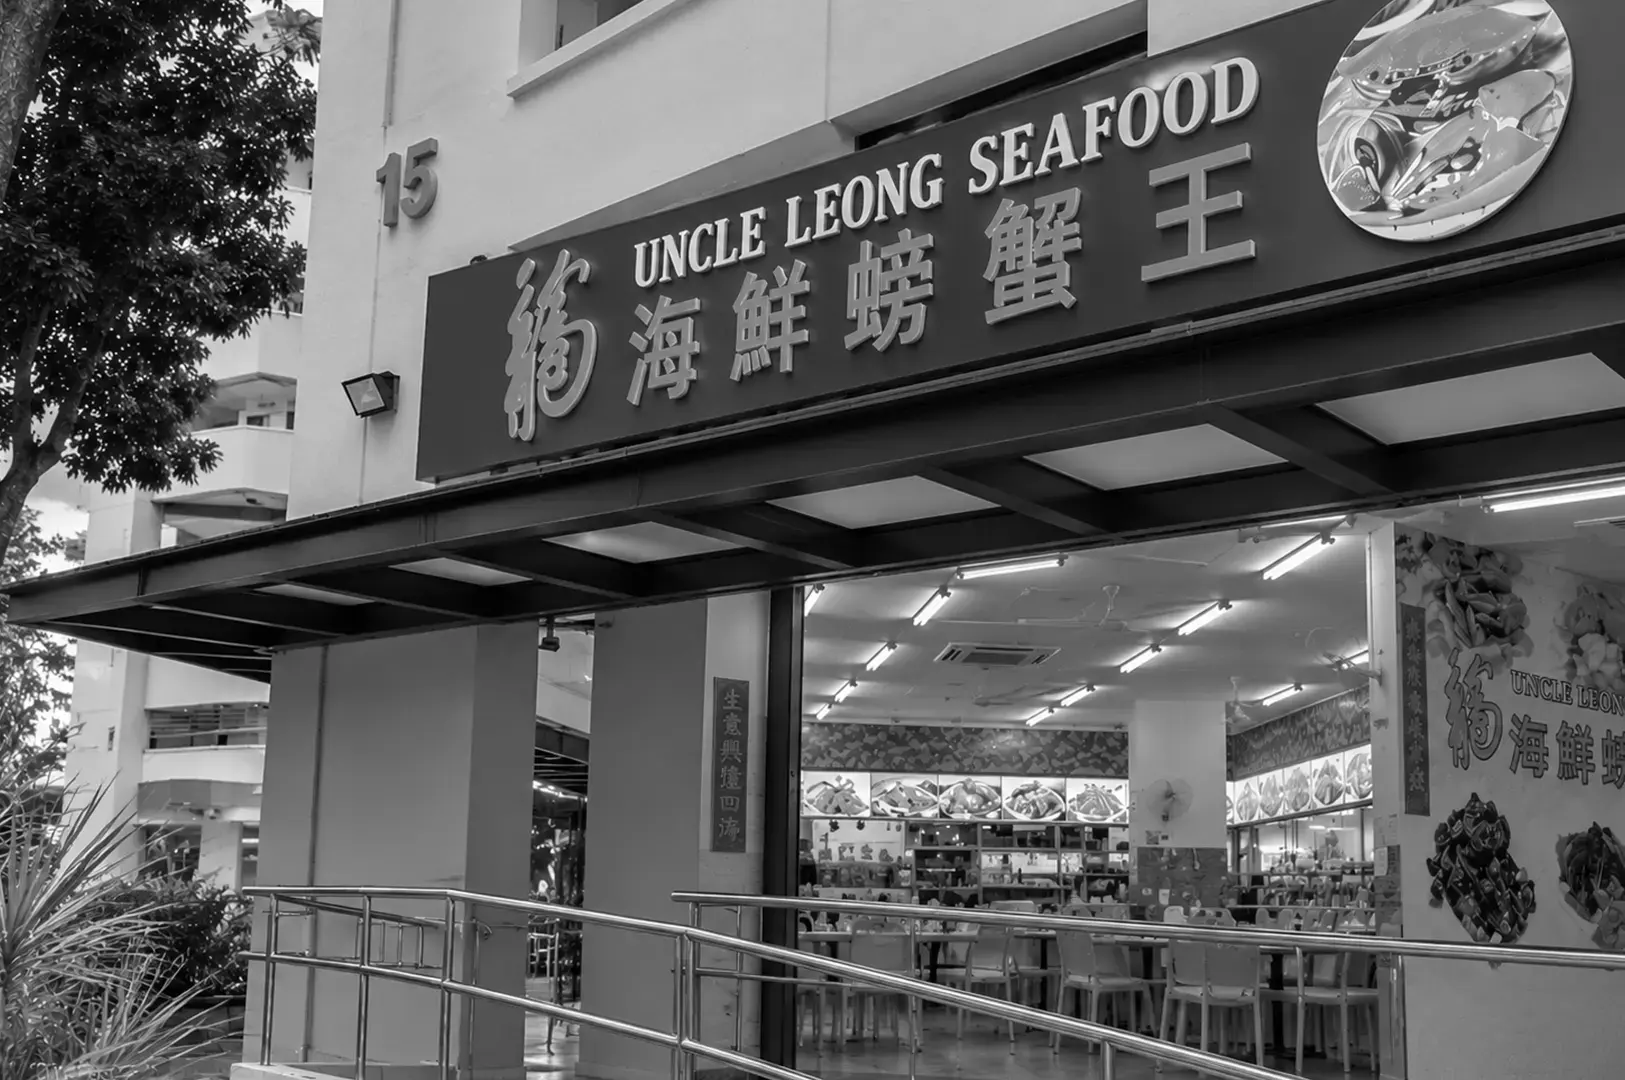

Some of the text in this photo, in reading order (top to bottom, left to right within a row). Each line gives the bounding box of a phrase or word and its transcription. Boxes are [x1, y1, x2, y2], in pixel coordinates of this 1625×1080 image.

[376, 137, 438, 227] 15
[634, 57, 1260, 287] UNCLE LEONG SEAFOOD
[1510, 669, 1573, 705] UNCLE
